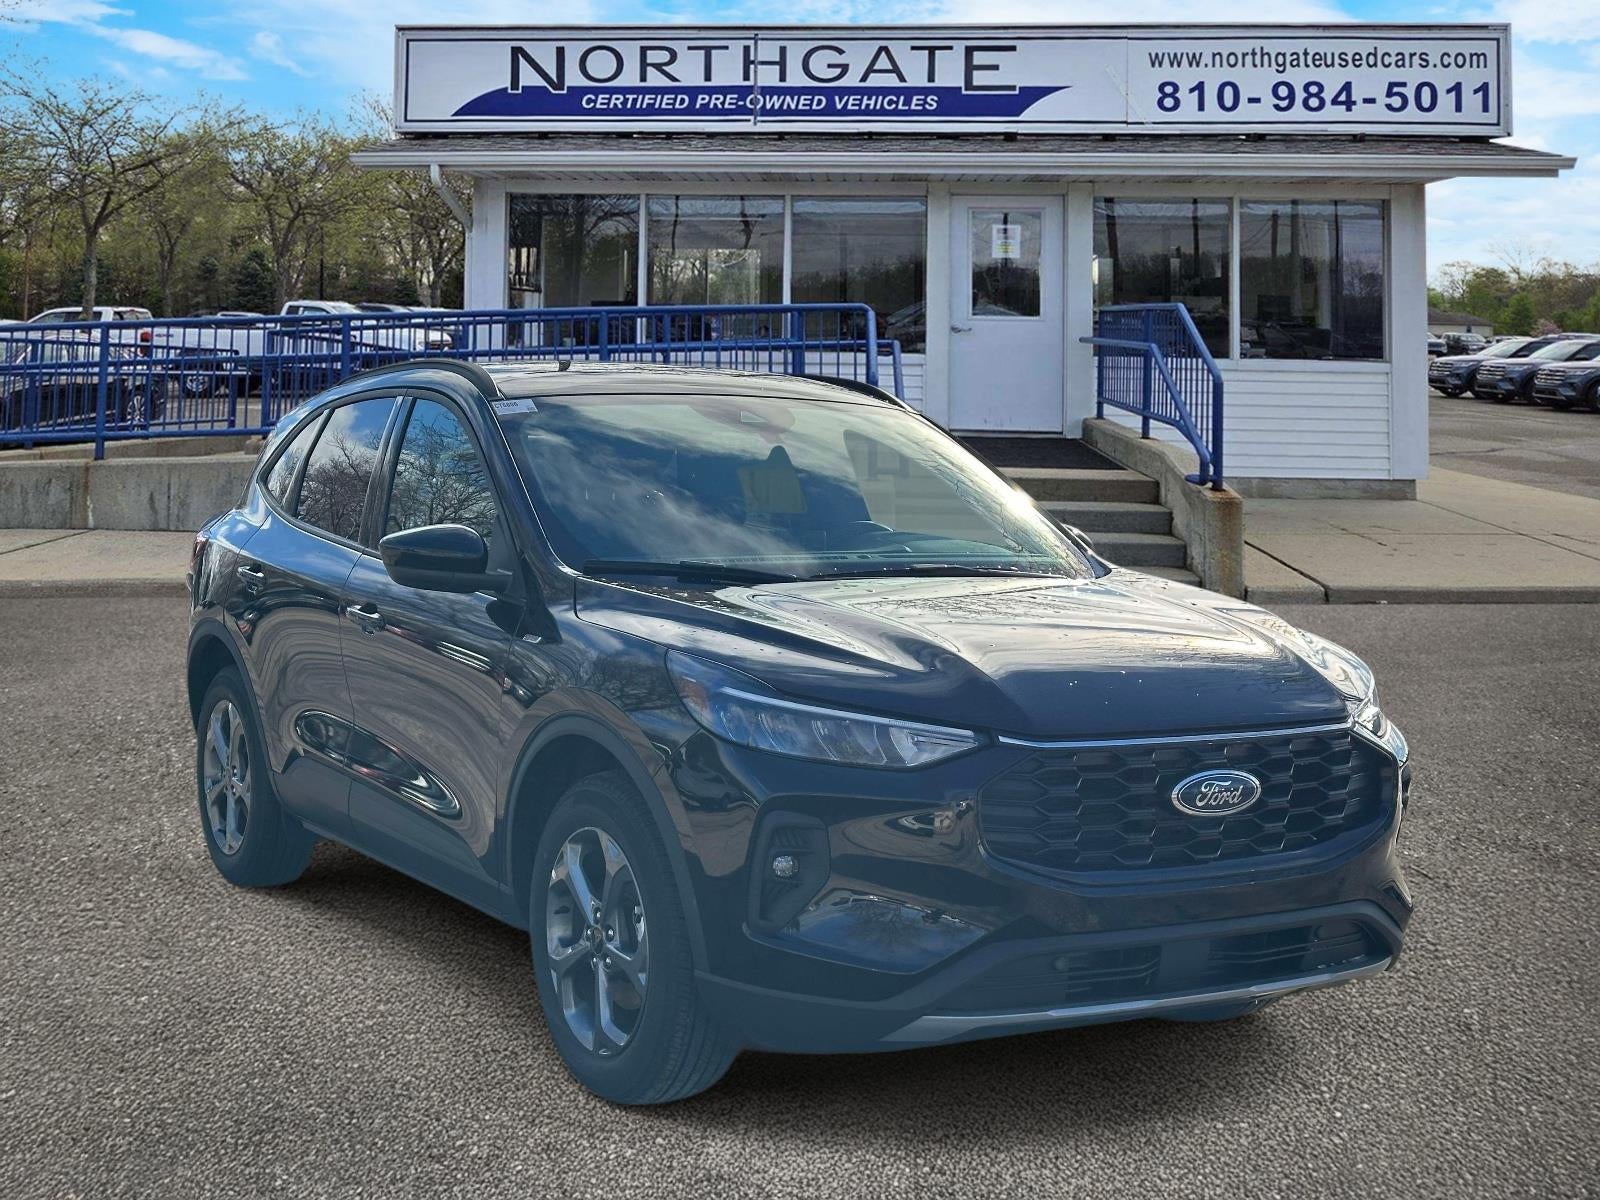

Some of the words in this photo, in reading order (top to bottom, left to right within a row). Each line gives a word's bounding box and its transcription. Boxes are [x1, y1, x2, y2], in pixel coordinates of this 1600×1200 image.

[510, 45, 1017, 92] NORTHGATE
[1148, 46, 1488, 73] www.northgateusedcars.com
[581, 94, 690, 109] CERTIFIED
[695, 94, 827, 110] PRE-OWNED
[835, 95, 939, 110] VEHICLES
[1156, 80, 1491, 113] 810-984-5011
[1196, 780, 1244, 807] Ford
